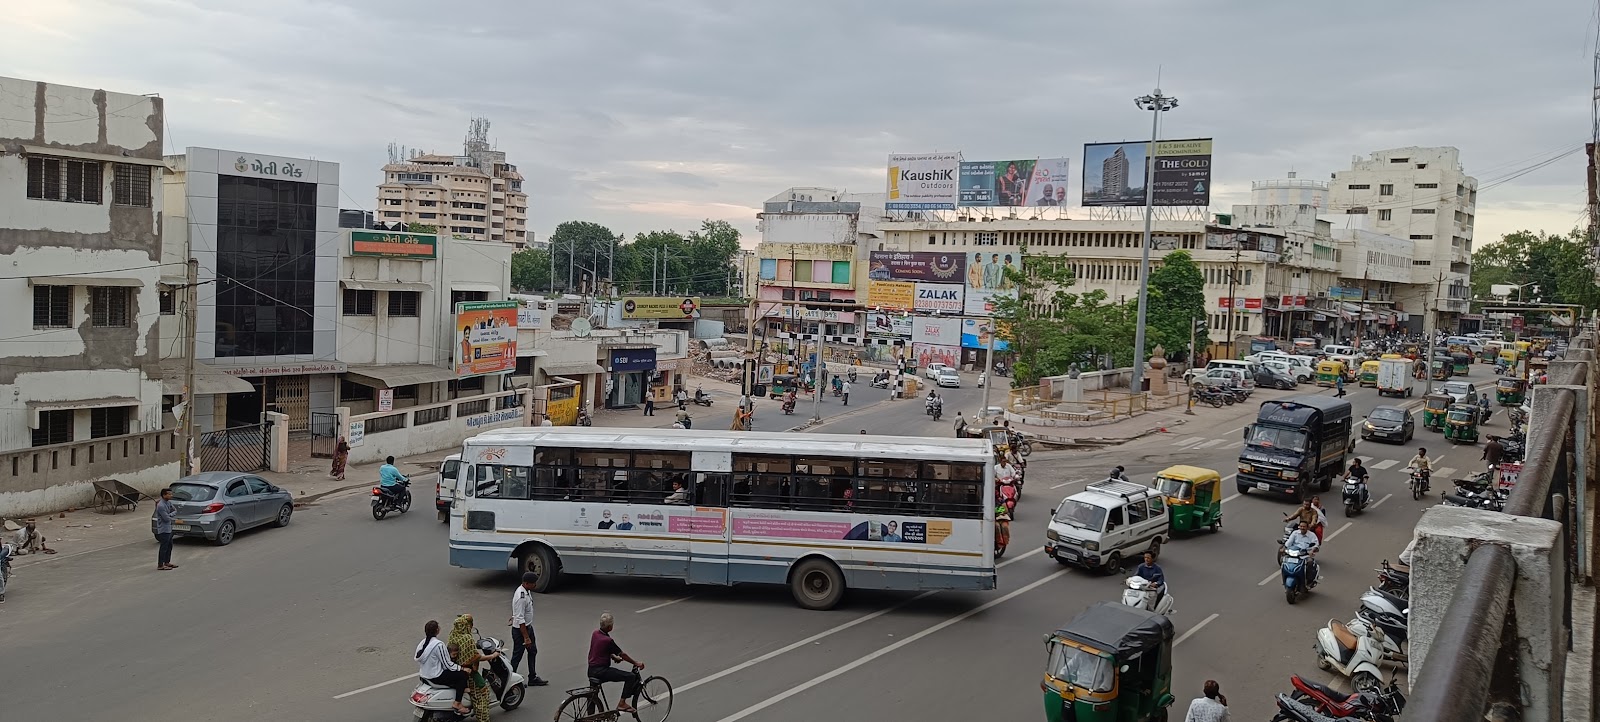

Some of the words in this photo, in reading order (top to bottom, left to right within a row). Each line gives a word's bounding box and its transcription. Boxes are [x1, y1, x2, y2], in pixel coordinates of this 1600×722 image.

[1160, 160, 1180, 168] THE
[1181, 159, 1208, 168] GOLD
[251, 159, 277, 175] ખેતી
[282, 163, 303, 178] બેંક
[901, 169, 953, 181] KaushiK
[382, 234, 400, 243] ખેતી
[405, 236, 419, 244] બેંક
[919, 289, 958, 300] ZALAK
[915, 300, 932, 308] 82380
[1268, 415, 1294, 423] POLICE
[1268, 457, 1291, 466] POLICE
